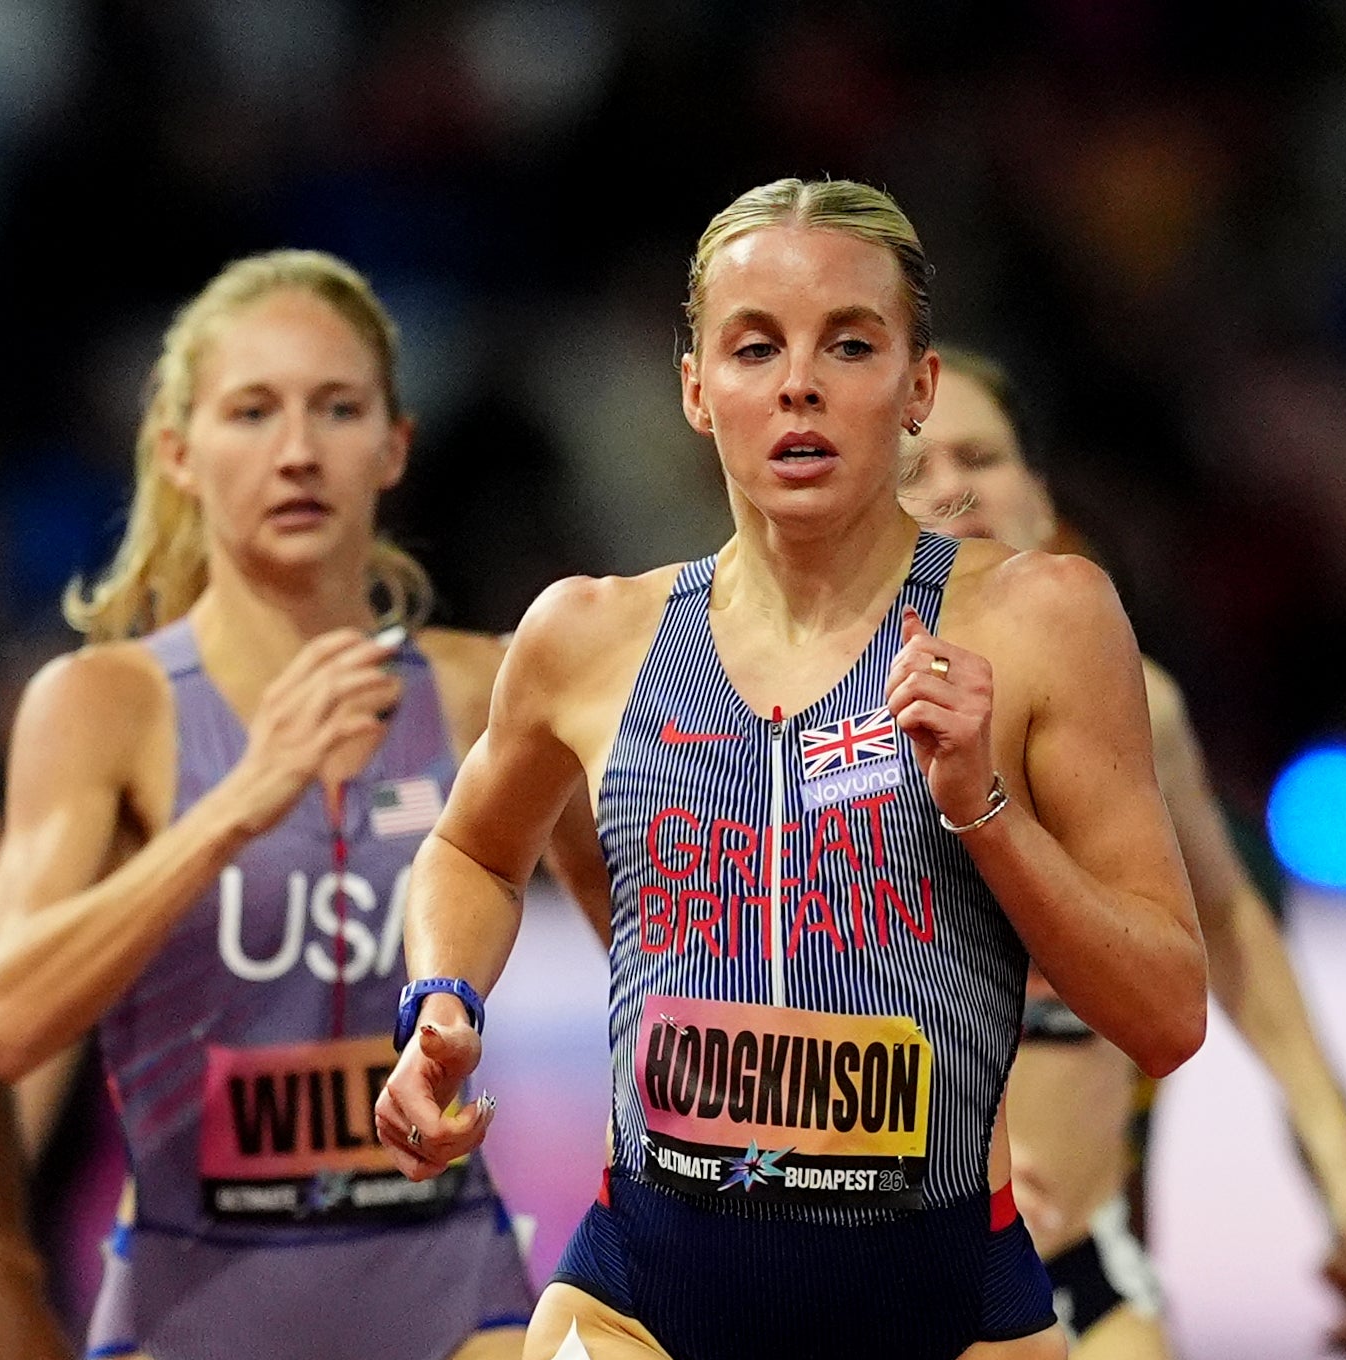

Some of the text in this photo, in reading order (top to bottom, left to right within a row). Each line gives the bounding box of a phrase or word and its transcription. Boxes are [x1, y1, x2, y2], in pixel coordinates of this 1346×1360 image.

[804, 766, 900, 806] Novuna
[647, 793, 896, 888] GREAT
[639, 876, 934, 962] BRITAIN
[645, 1023, 921, 1133] HODGKINSON
[657, 1146, 904, 1192] ULTIMATE BUDAPEST 26
